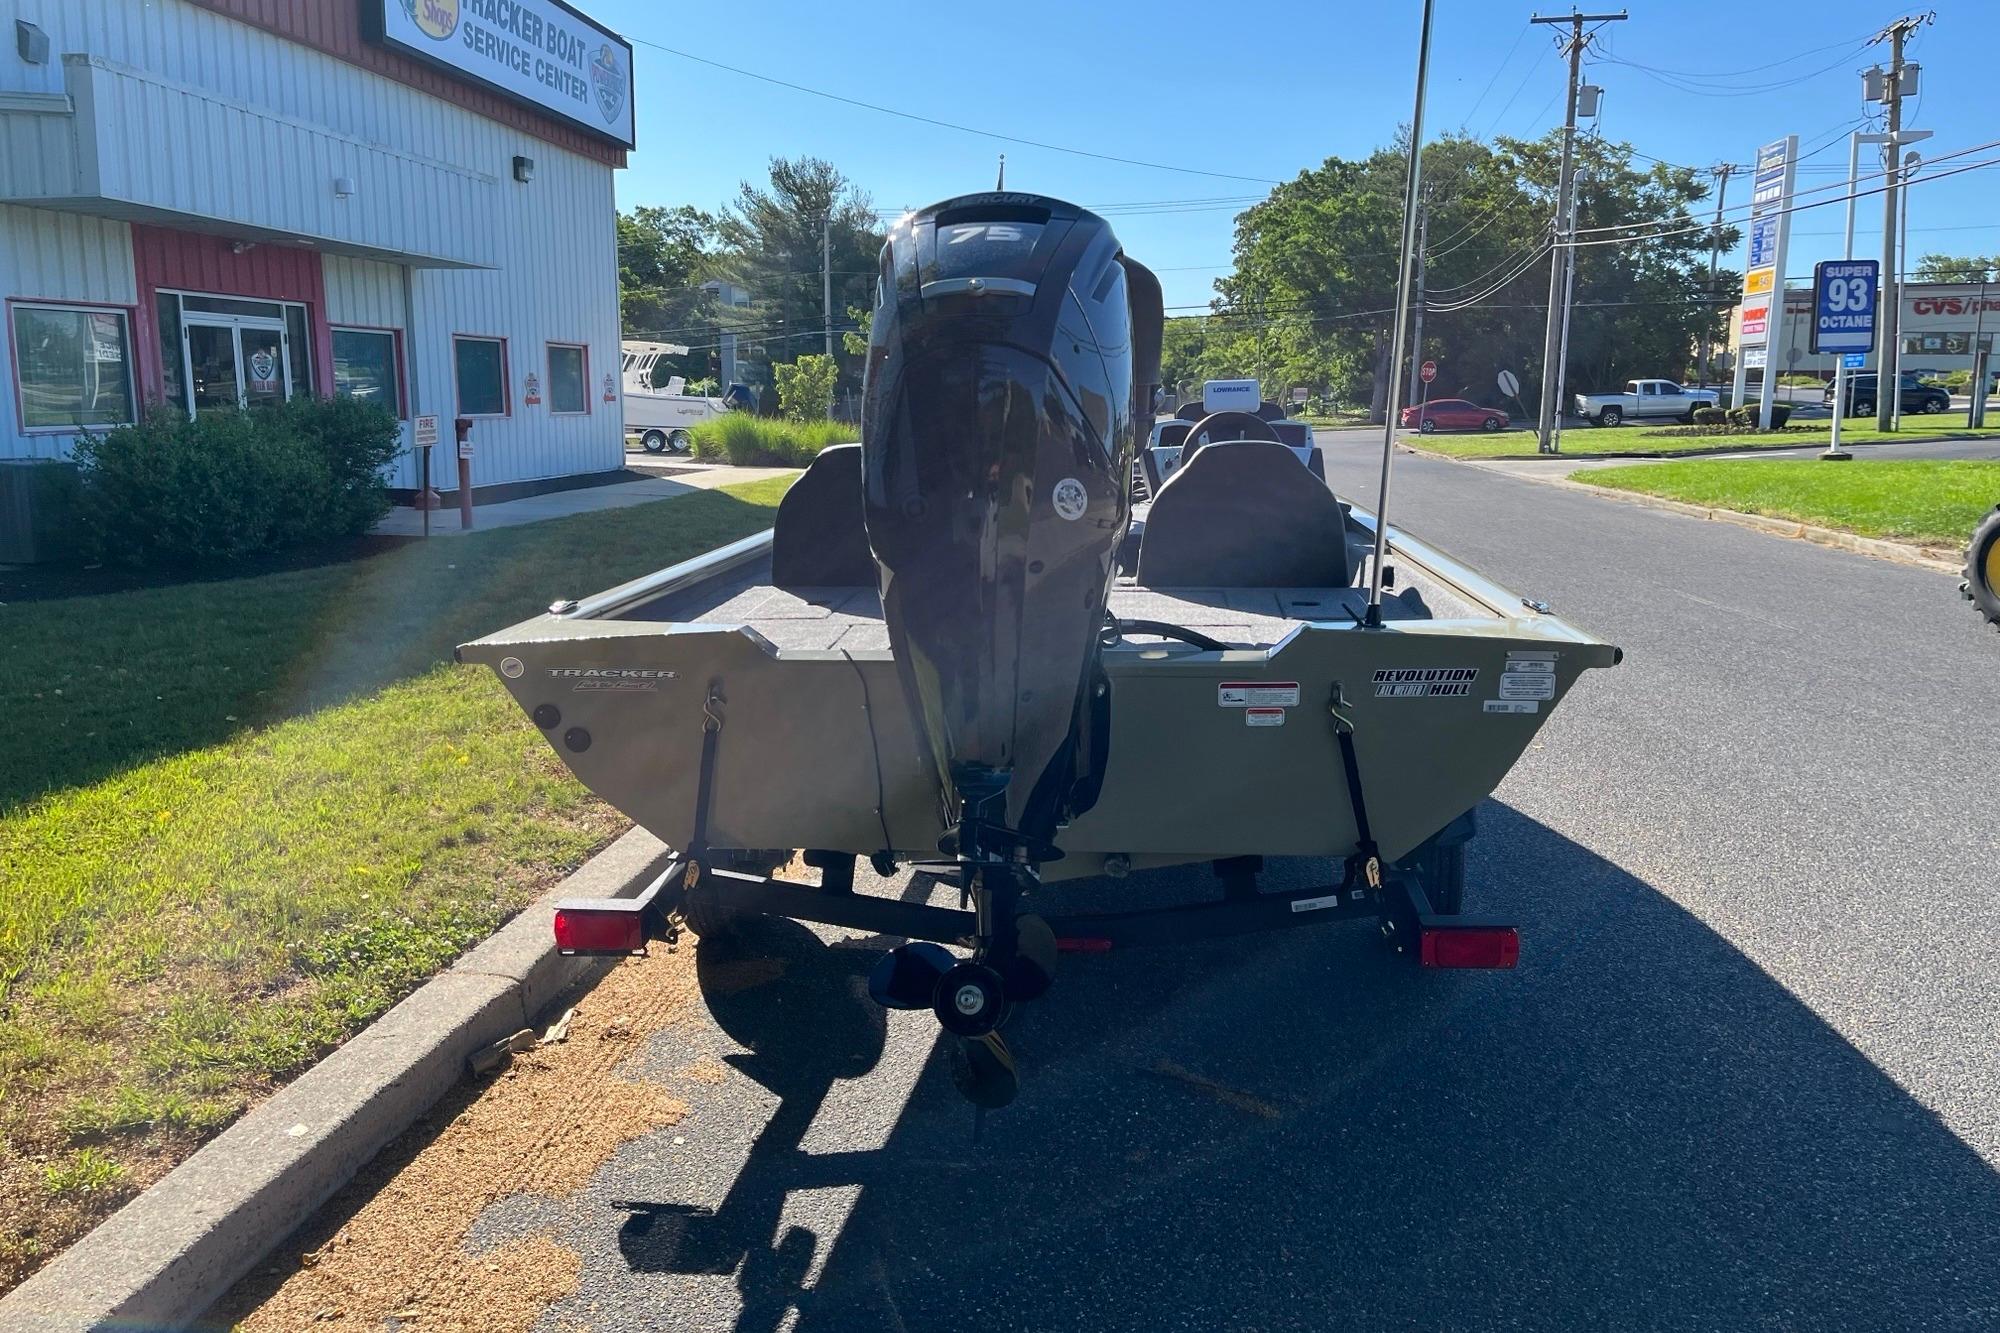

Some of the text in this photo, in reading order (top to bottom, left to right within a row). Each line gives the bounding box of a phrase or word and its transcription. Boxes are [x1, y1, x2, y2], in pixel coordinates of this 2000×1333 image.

[546, 22, 586, 70] BOAT
[462, 21, 531, 77] SERVICE
[535, 57, 588, 105] CENTER
[947, 226, 1022, 245] 75
[1826, 265, 1872, 277] SUPER
[1828, 277, 1868, 312] 93
[1820, 315, 1872, 329] OCTANE
[1422, 367, 1436, 376] STOP
[419, 418, 435, 429] FIRE
[547, 669, 676, 678] TRACKER
[1373, 669, 1478, 682] REVOLUTION
[1428, 683, 1471, 696] HULL
